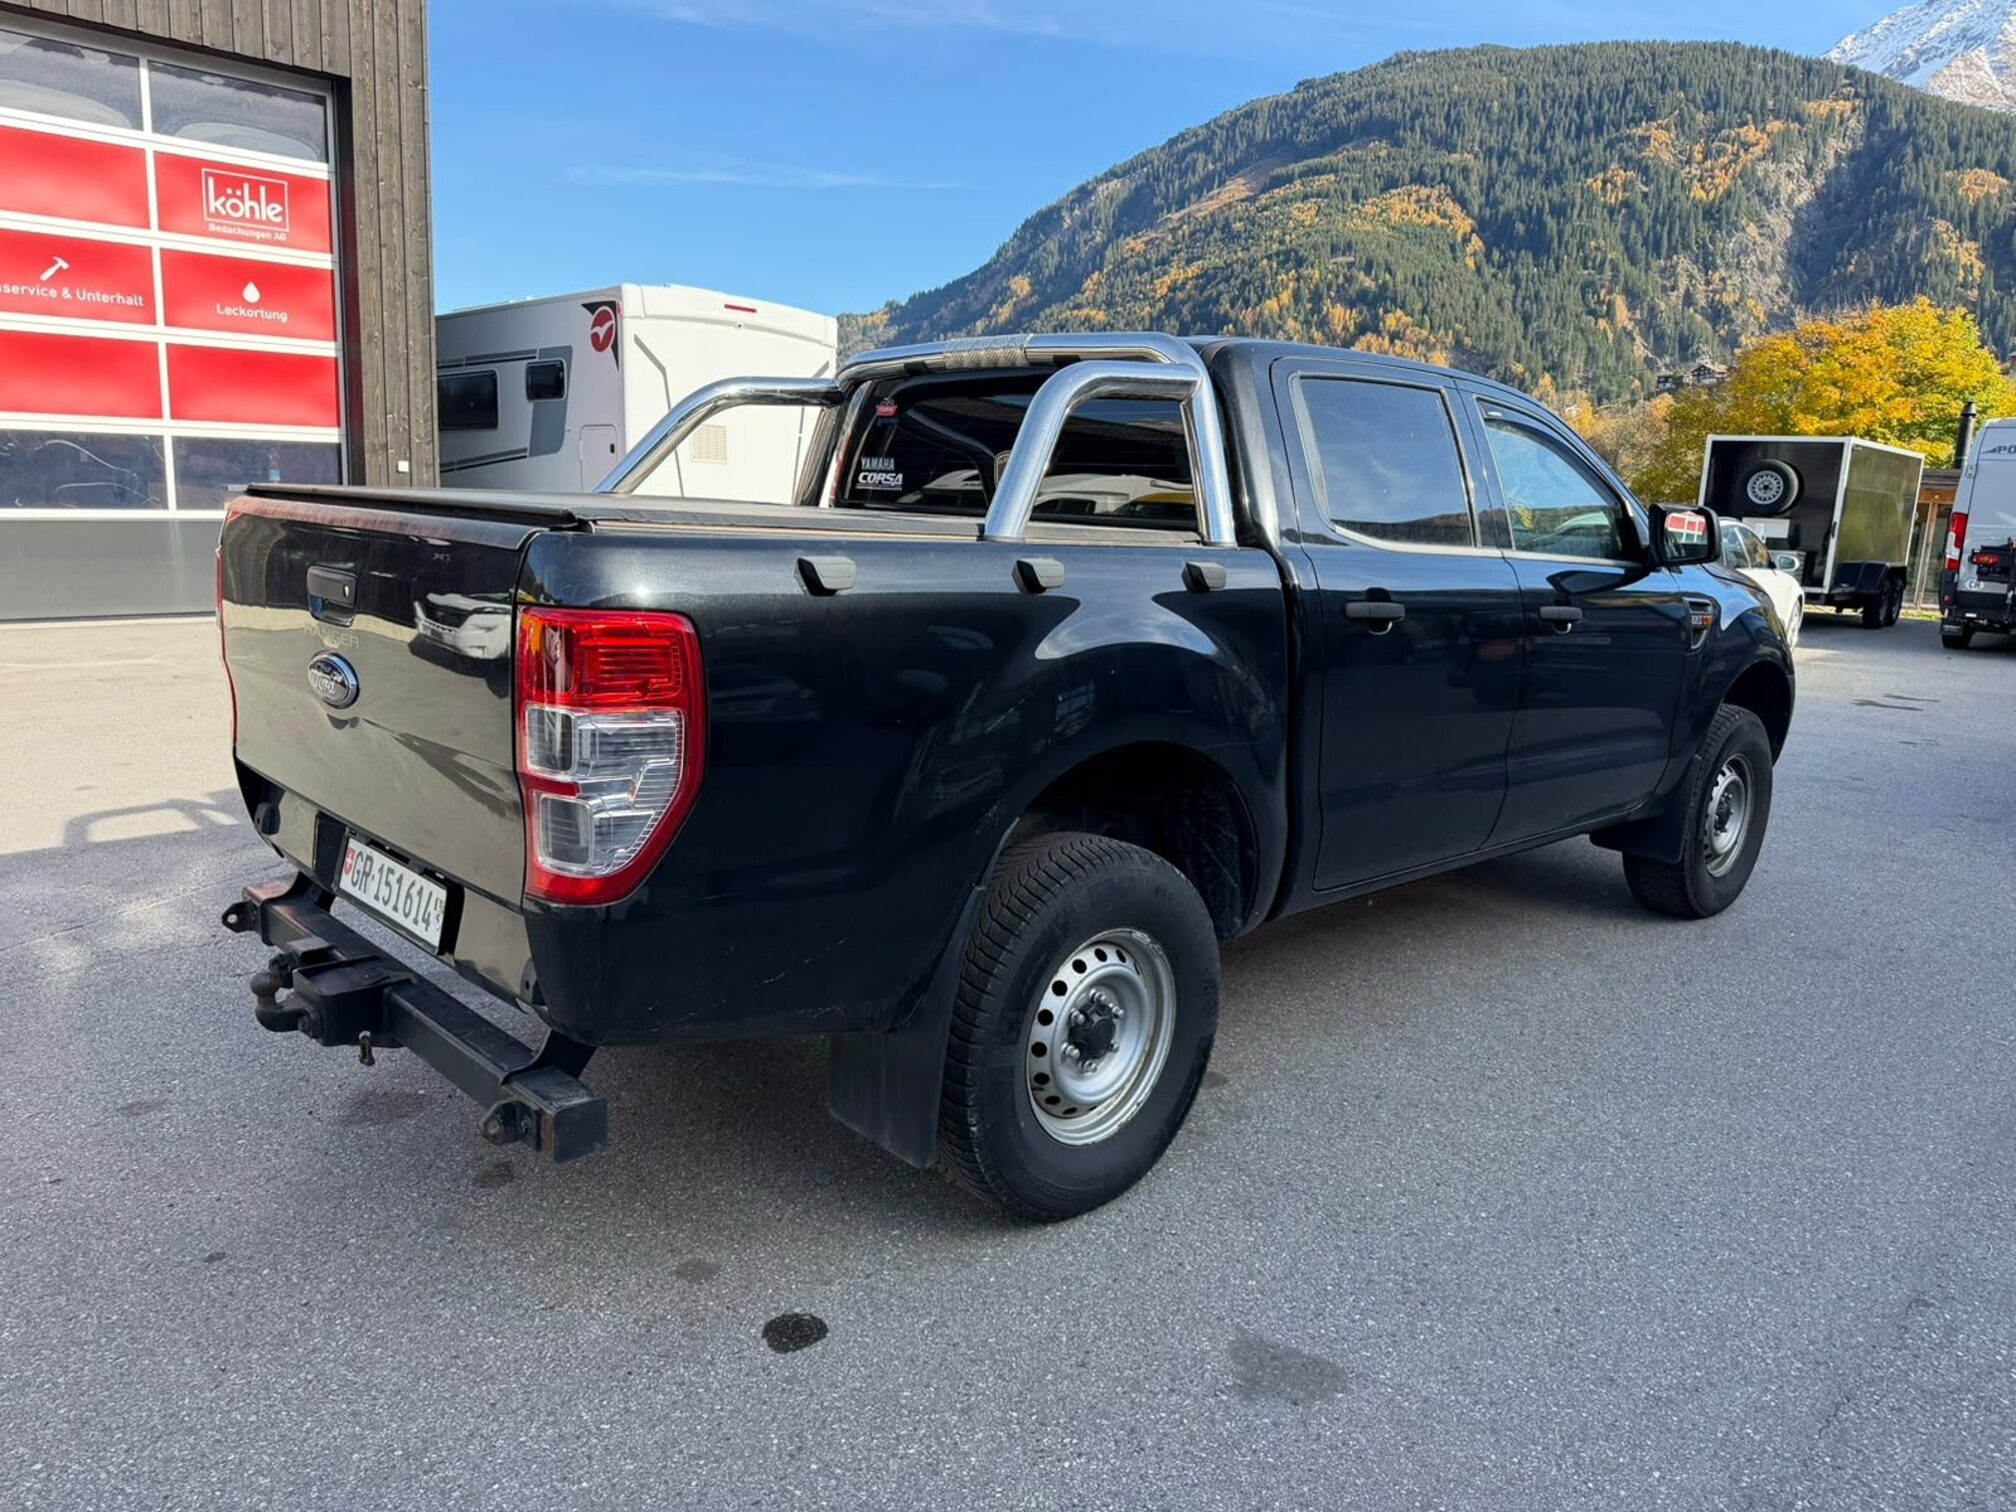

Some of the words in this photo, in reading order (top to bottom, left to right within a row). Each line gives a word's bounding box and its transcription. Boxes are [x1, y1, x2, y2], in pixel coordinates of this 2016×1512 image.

[208, 176, 283, 223] köhle
[208, 222, 272, 240] Bedachungen
[273, 232, 287, 241] AG
[61, 287, 72, 299] &
[76, 289, 144, 306] Unterhalt
[216, 303, 288, 323] Leckortung
[861, 457, 895, 470] YAMAHA
[858, 472, 903, 486] CORSA
